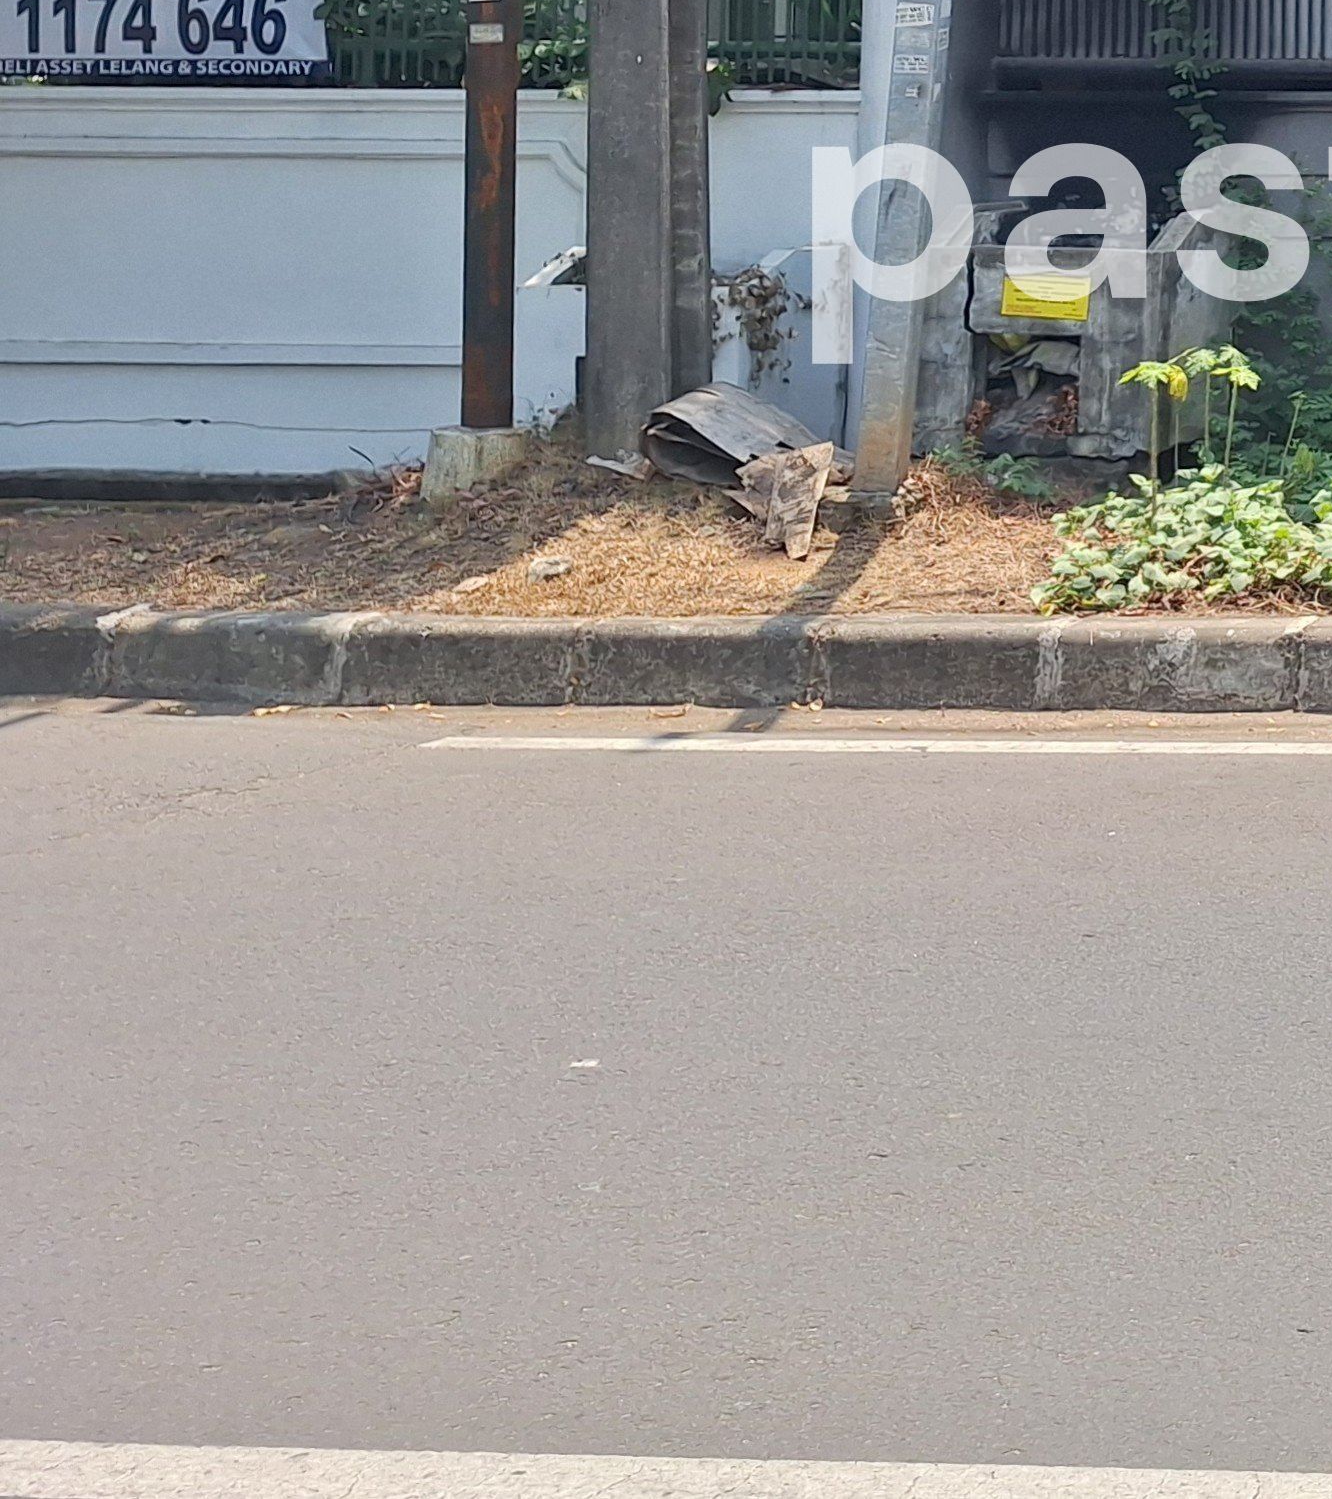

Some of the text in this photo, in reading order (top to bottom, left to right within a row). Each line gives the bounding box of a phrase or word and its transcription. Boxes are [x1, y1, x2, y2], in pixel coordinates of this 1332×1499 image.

[36, 60, 93, 75] ASSET
[100, 59, 173, 76] LELANG
[177, 60, 192, 75] &
[196, 59, 313, 77] SECONDARY
